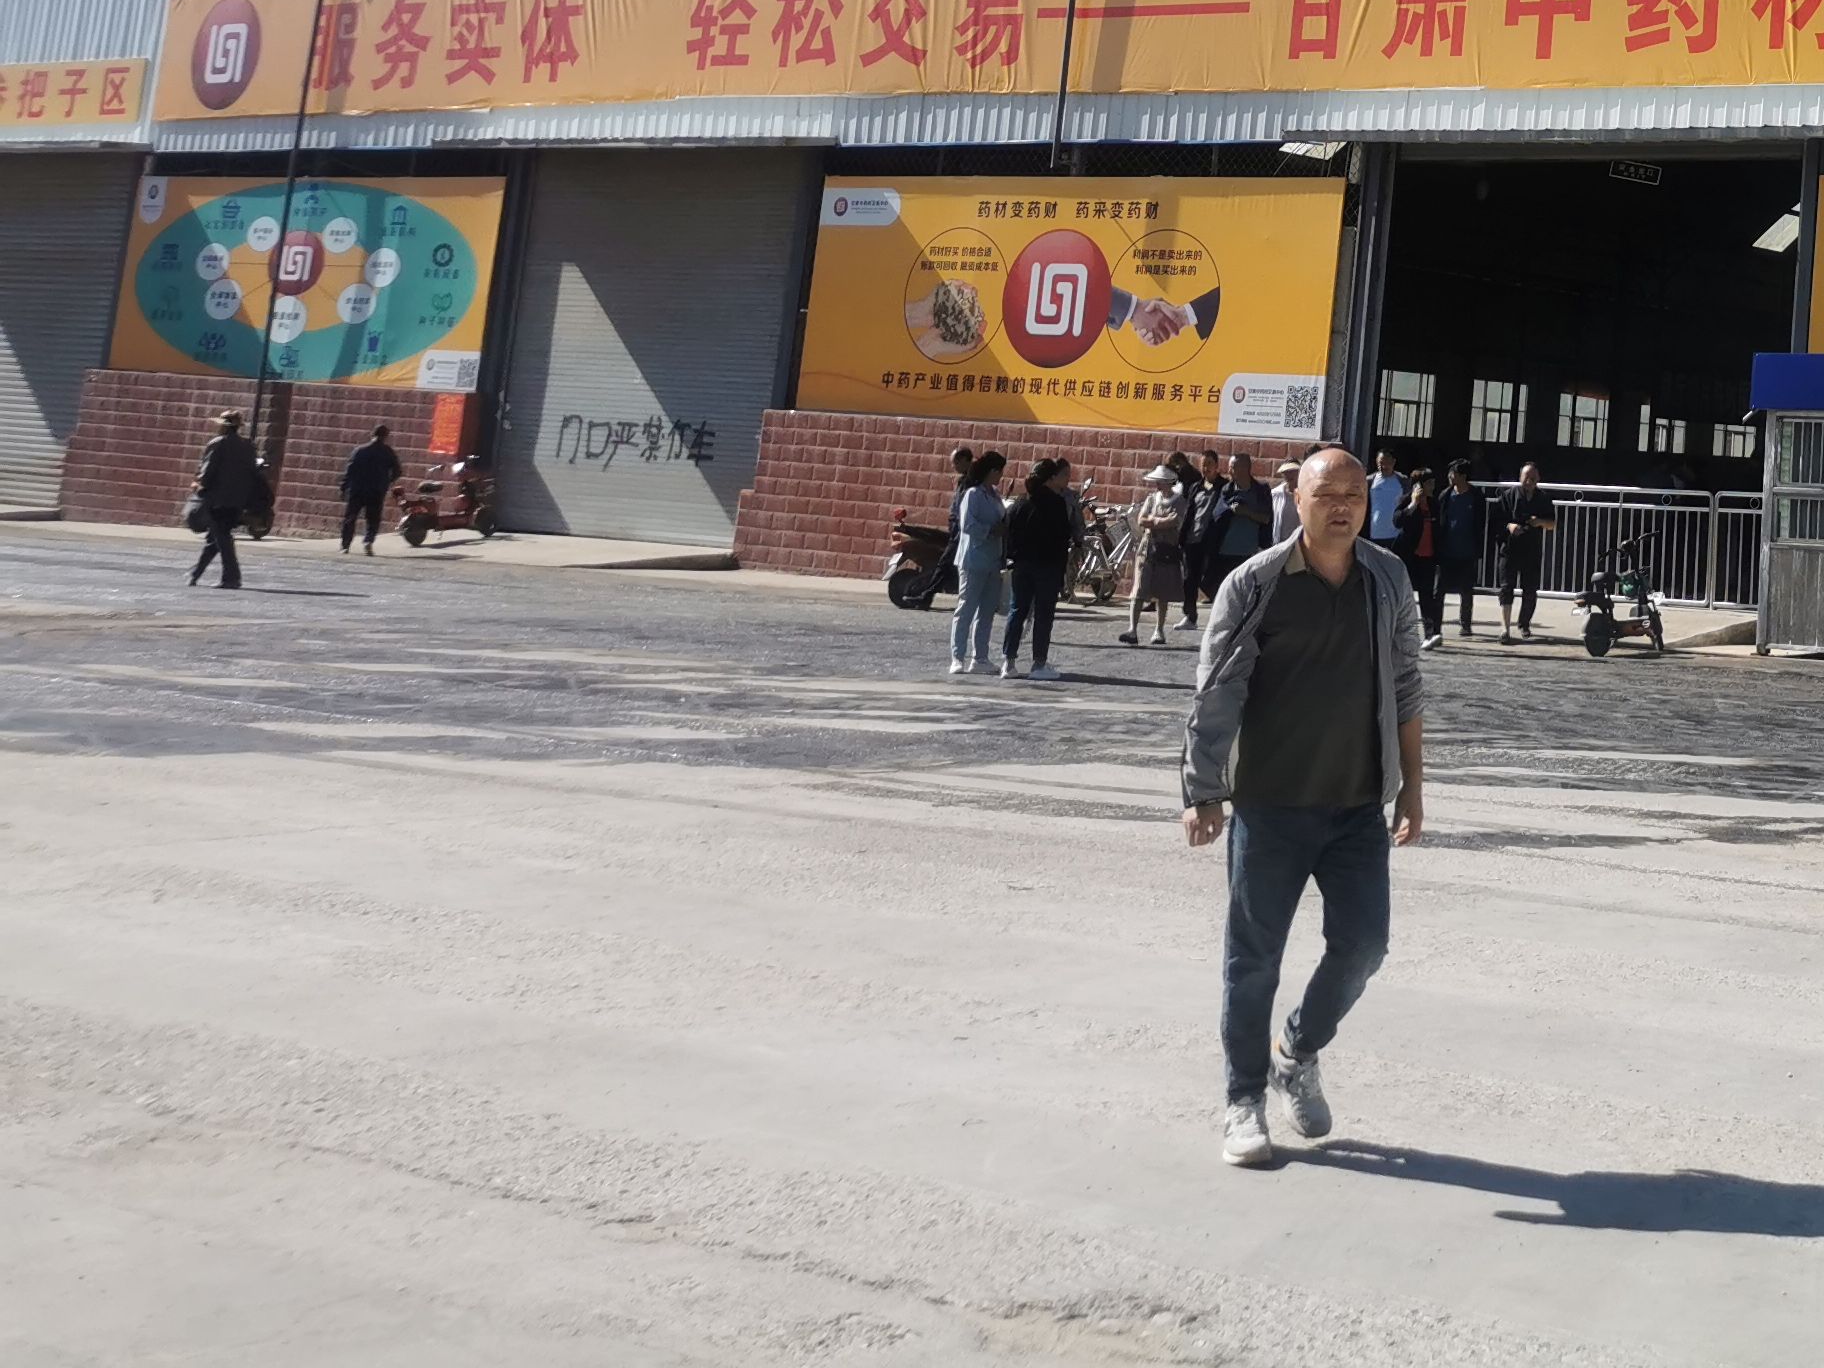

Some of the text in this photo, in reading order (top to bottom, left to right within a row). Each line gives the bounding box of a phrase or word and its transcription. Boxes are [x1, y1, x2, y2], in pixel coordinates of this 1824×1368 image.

[976, 200, 1160, 220] 药材变药财 药采变药财
[881, 370, 1221, 403] 中药产业值得信赖的现代供应链创新服务平台
